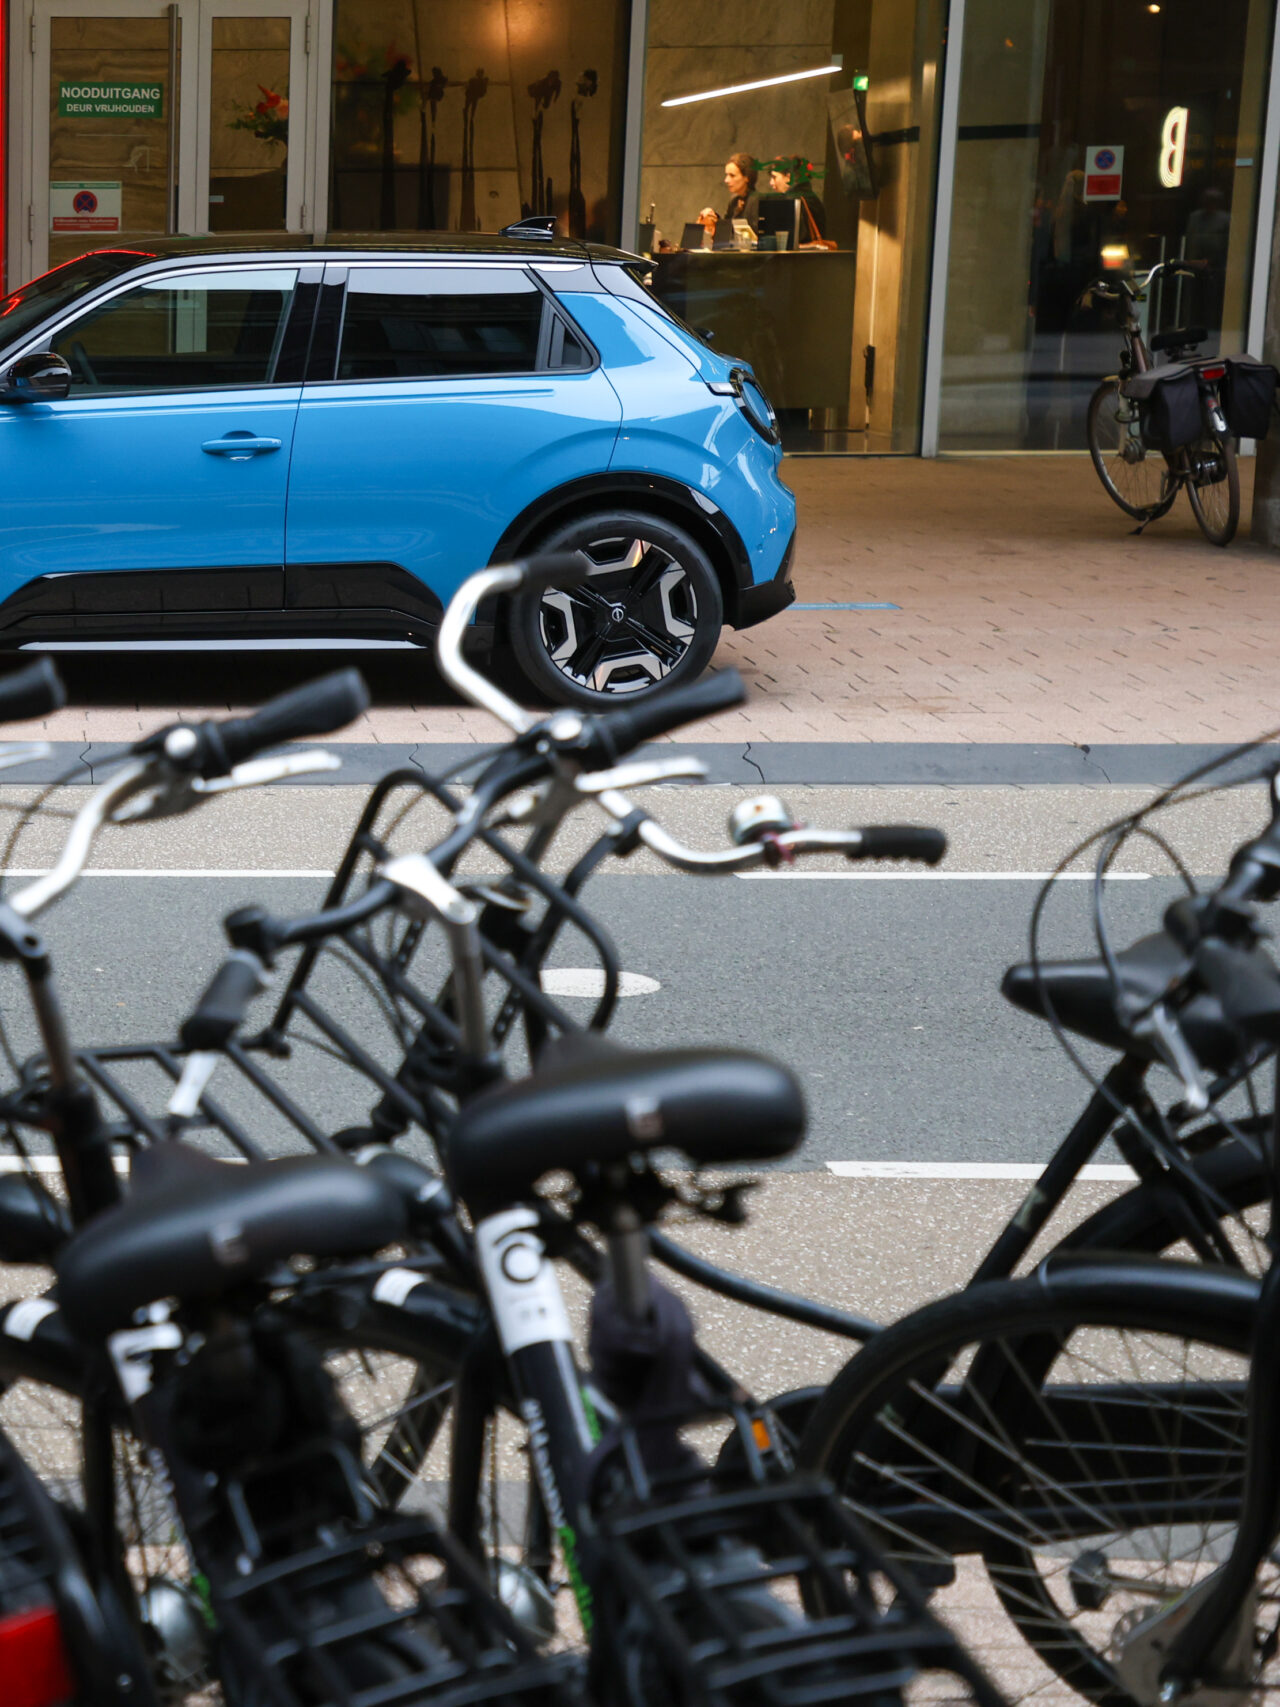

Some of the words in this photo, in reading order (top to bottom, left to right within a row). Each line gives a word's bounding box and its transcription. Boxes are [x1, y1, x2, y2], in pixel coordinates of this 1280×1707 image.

[61, 87, 161, 99] NOODUITGANG
[66, 103, 93, 113] DEUR
[94, 104, 155, 113] VRIJHOUDEN
